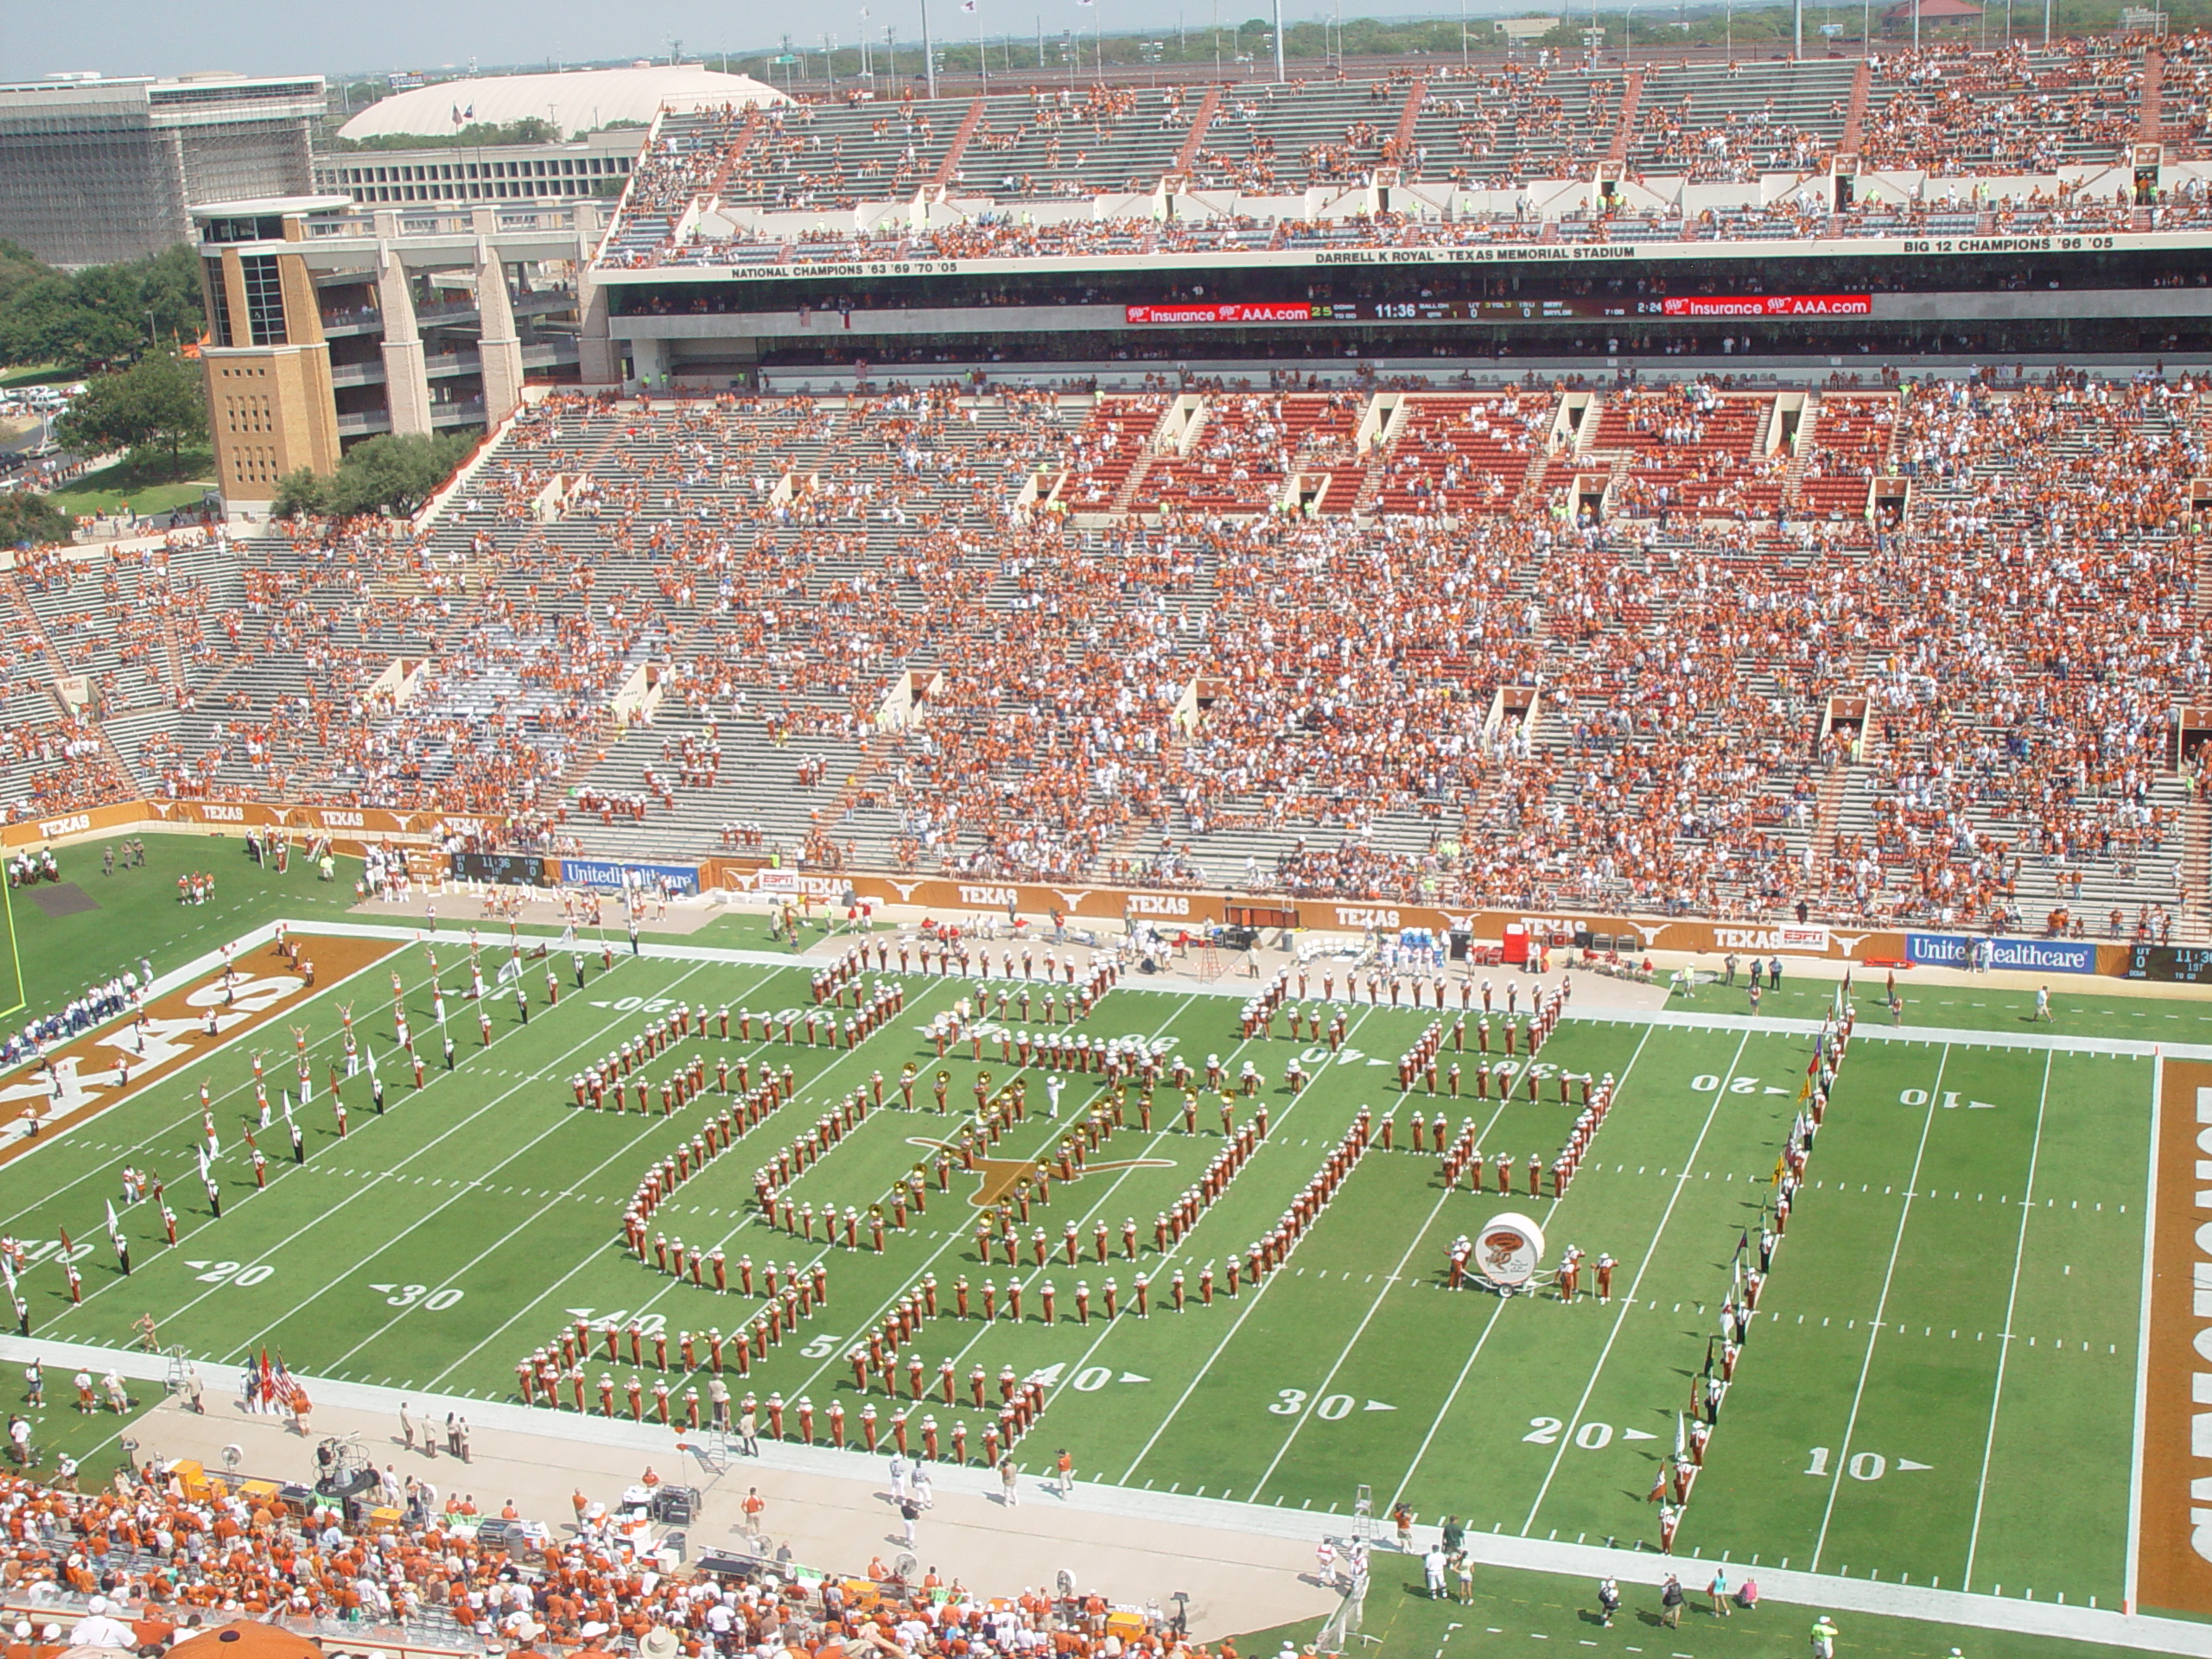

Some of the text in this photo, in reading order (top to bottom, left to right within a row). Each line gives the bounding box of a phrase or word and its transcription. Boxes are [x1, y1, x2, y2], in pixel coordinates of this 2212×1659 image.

[1904, 237, 2113, 252] BIG 12 CHAMPIONS '96 '05
[1316, 252, 1376, 264] DARRELL
[1379, 252, 1388, 262] K
[1392, 251, 1434, 262] ROYAL
[1447, 250, 1493, 261] TEXAS
[1497, 248, 1567, 260] MEMORIAL
[1573, 246, 1635, 258] STADIUM
[732, 262, 957, 278] NATIONAL CHAMPIONS '63 '69 '70 '05
[1150, 308, 1308, 322] Insurance AAA.com
[1375, 303, 1415, 317] 11:36
[1690, 301, 1866, 315] Insurance AAA.com
[201, 805, 245, 820] TEXAS
[320, 811, 365, 827] TEXAS
[39, 814, 90, 837] TEXAS
[457, 862, 464, 872] 0
[482, 856, 511, 868] 11:36
[529, 867, 537, 876] 0
[799, 877, 853, 895] TEXAS
[958, 886, 1017, 905] TEXAS
[1128, 895, 1190, 915] TEXAS
[1336, 908, 1400, 928] TEXAS
[1521, 917, 1586, 938] TEXAS
[1784, 930, 1823, 941] ESPN
[1713, 929, 1780, 950] TEXAS
[2137, 947, 2151, 956] UT
[2136, 956, 2145, 968] 0
[1299, 1046, 1366, 1065] 40
[1690, 1074, 1760, 1095] 20
[1899, 1088, 1962, 1109] 10
[194, 1261, 276, 1287] 20
[386, 1284, 465, 1311] 30
[1268, 1389, 1356, 1421] 30
[1522, 1416, 1614, 1450] 20
[1803, 1446, 1887, 1481] 10
